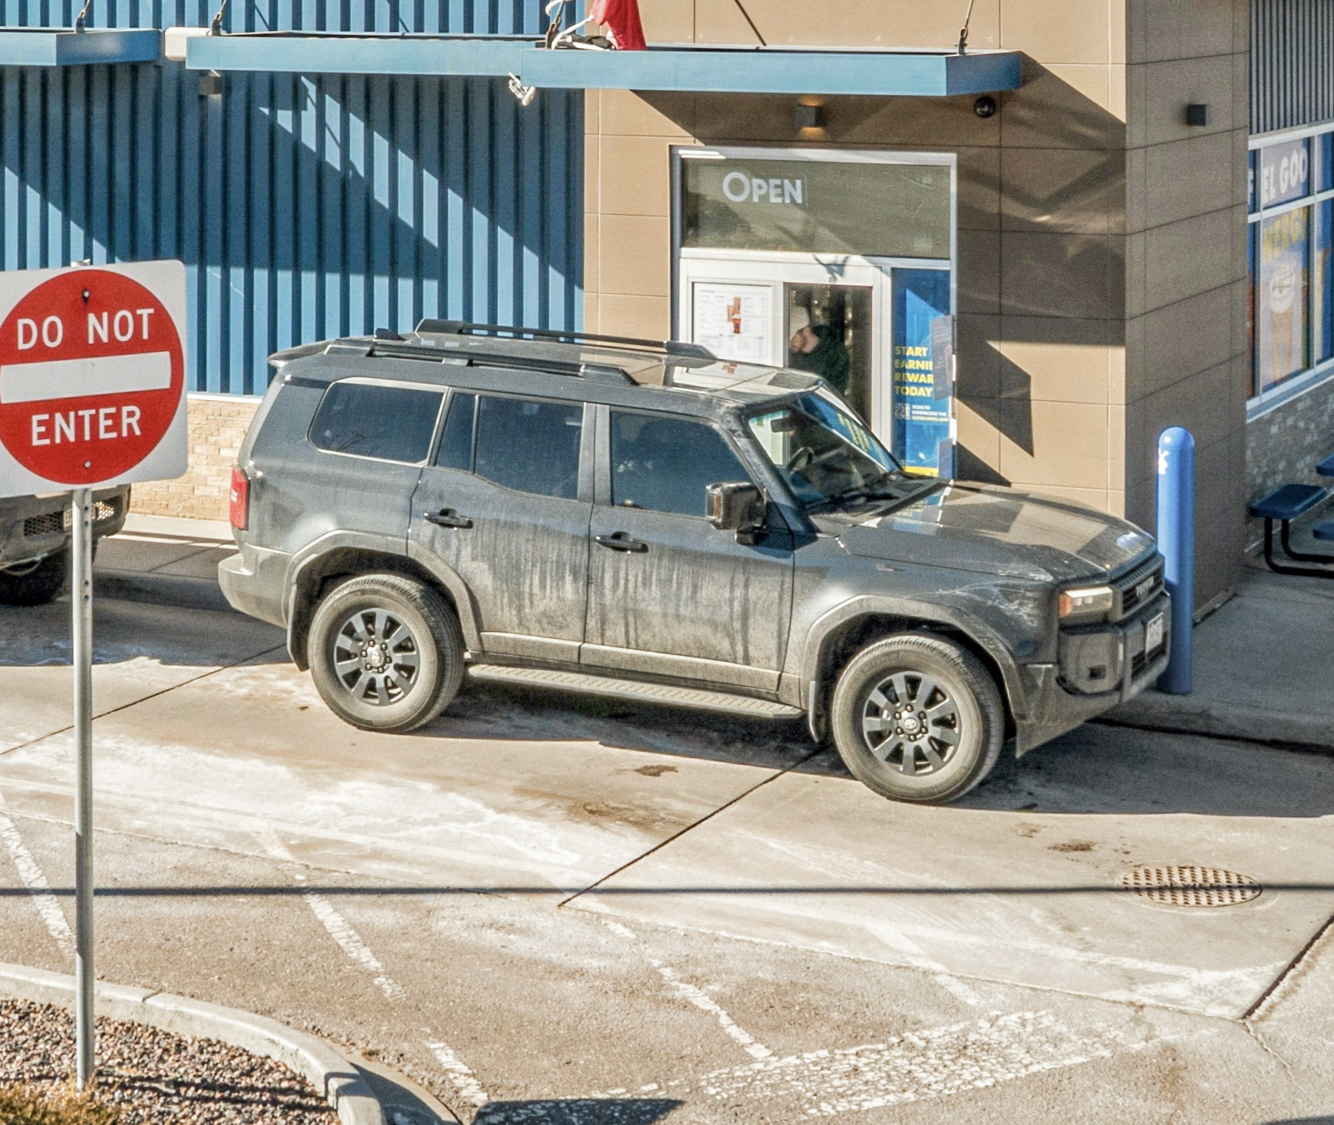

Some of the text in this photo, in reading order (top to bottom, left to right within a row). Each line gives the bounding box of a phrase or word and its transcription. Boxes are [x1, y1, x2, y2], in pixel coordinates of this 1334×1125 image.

[1279, 147, 1308, 194] GOO
[722, 171, 803, 204] OPEN
[1262, 206, 1308, 264] NERGY
[17, 308, 155, 350] DO NOT
[894, 345, 928, 357] START
[894, 359, 934, 371] EARNI
[894, 372, 934, 384] REWAR
[894, 385, 933, 398] TODAY
[31, 405, 142, 447] ENTER
